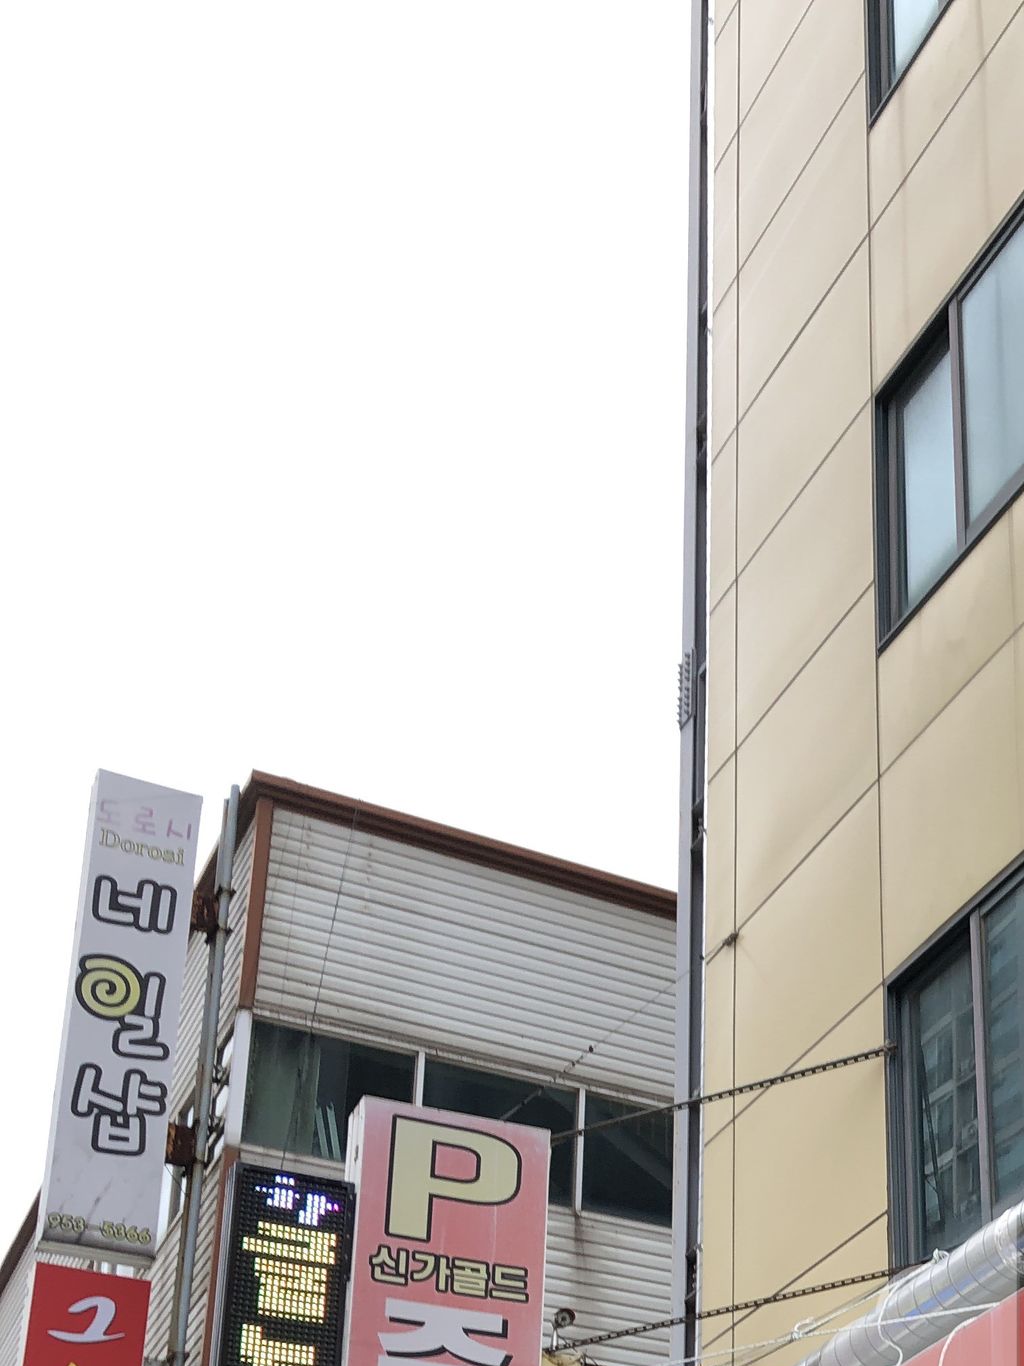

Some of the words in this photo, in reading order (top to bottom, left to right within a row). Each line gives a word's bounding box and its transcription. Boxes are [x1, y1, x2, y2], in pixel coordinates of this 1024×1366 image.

[99, 828, 185, 866] Dorosi
[383, 1113, 523, 1244] P
[368, 1244, 530, 1304] 신가골드
[47, 1295, 126, 1344] 그
